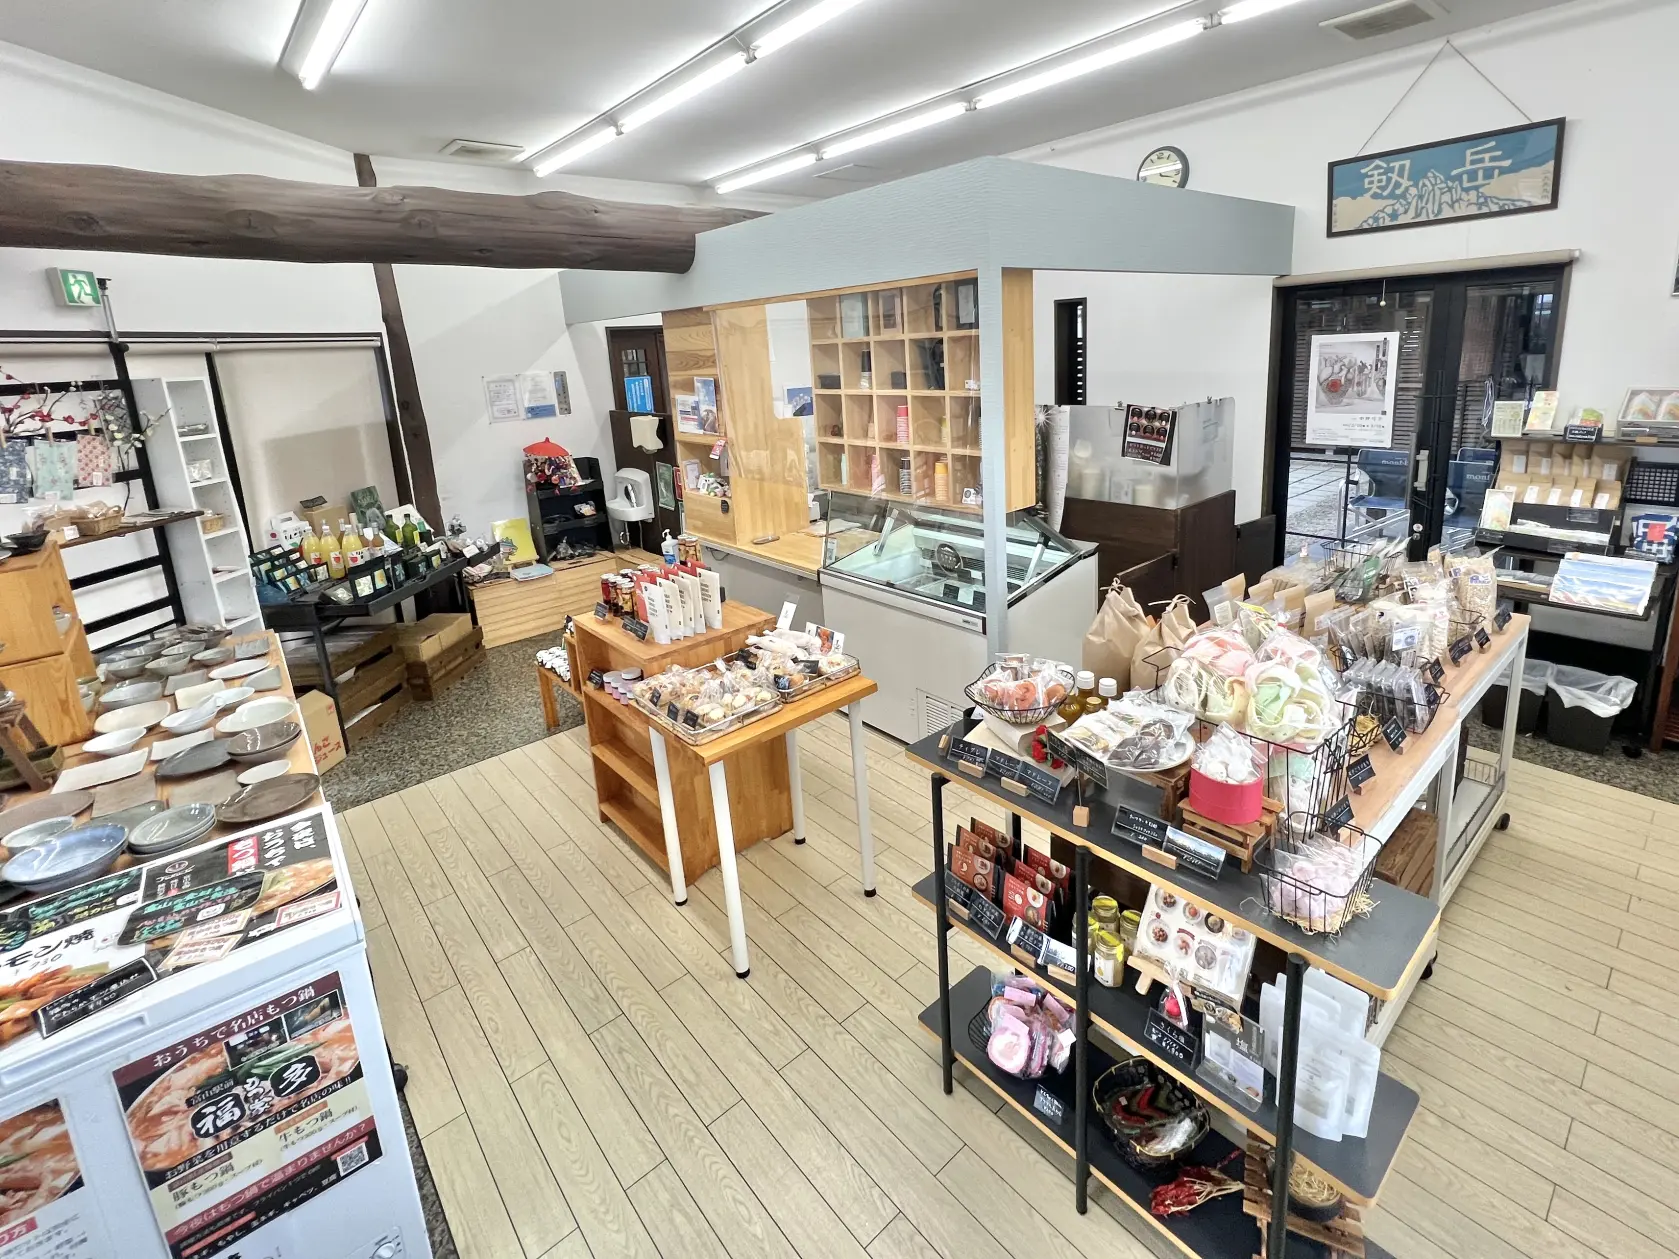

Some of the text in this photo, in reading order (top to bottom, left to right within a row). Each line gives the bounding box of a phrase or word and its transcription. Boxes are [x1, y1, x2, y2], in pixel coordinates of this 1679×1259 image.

[1156, 152, 1164, 160] 12
[152, 985, 315, 1067] おうちで名店もつ鍋
[275, 1057, 315, 1096] 多
[193, 1094, 242, 1138] 福
[278, 1108, 333, 1144] 牛もつ鍋
[171, 1161, 234, 1202] 豚もつ鍋
